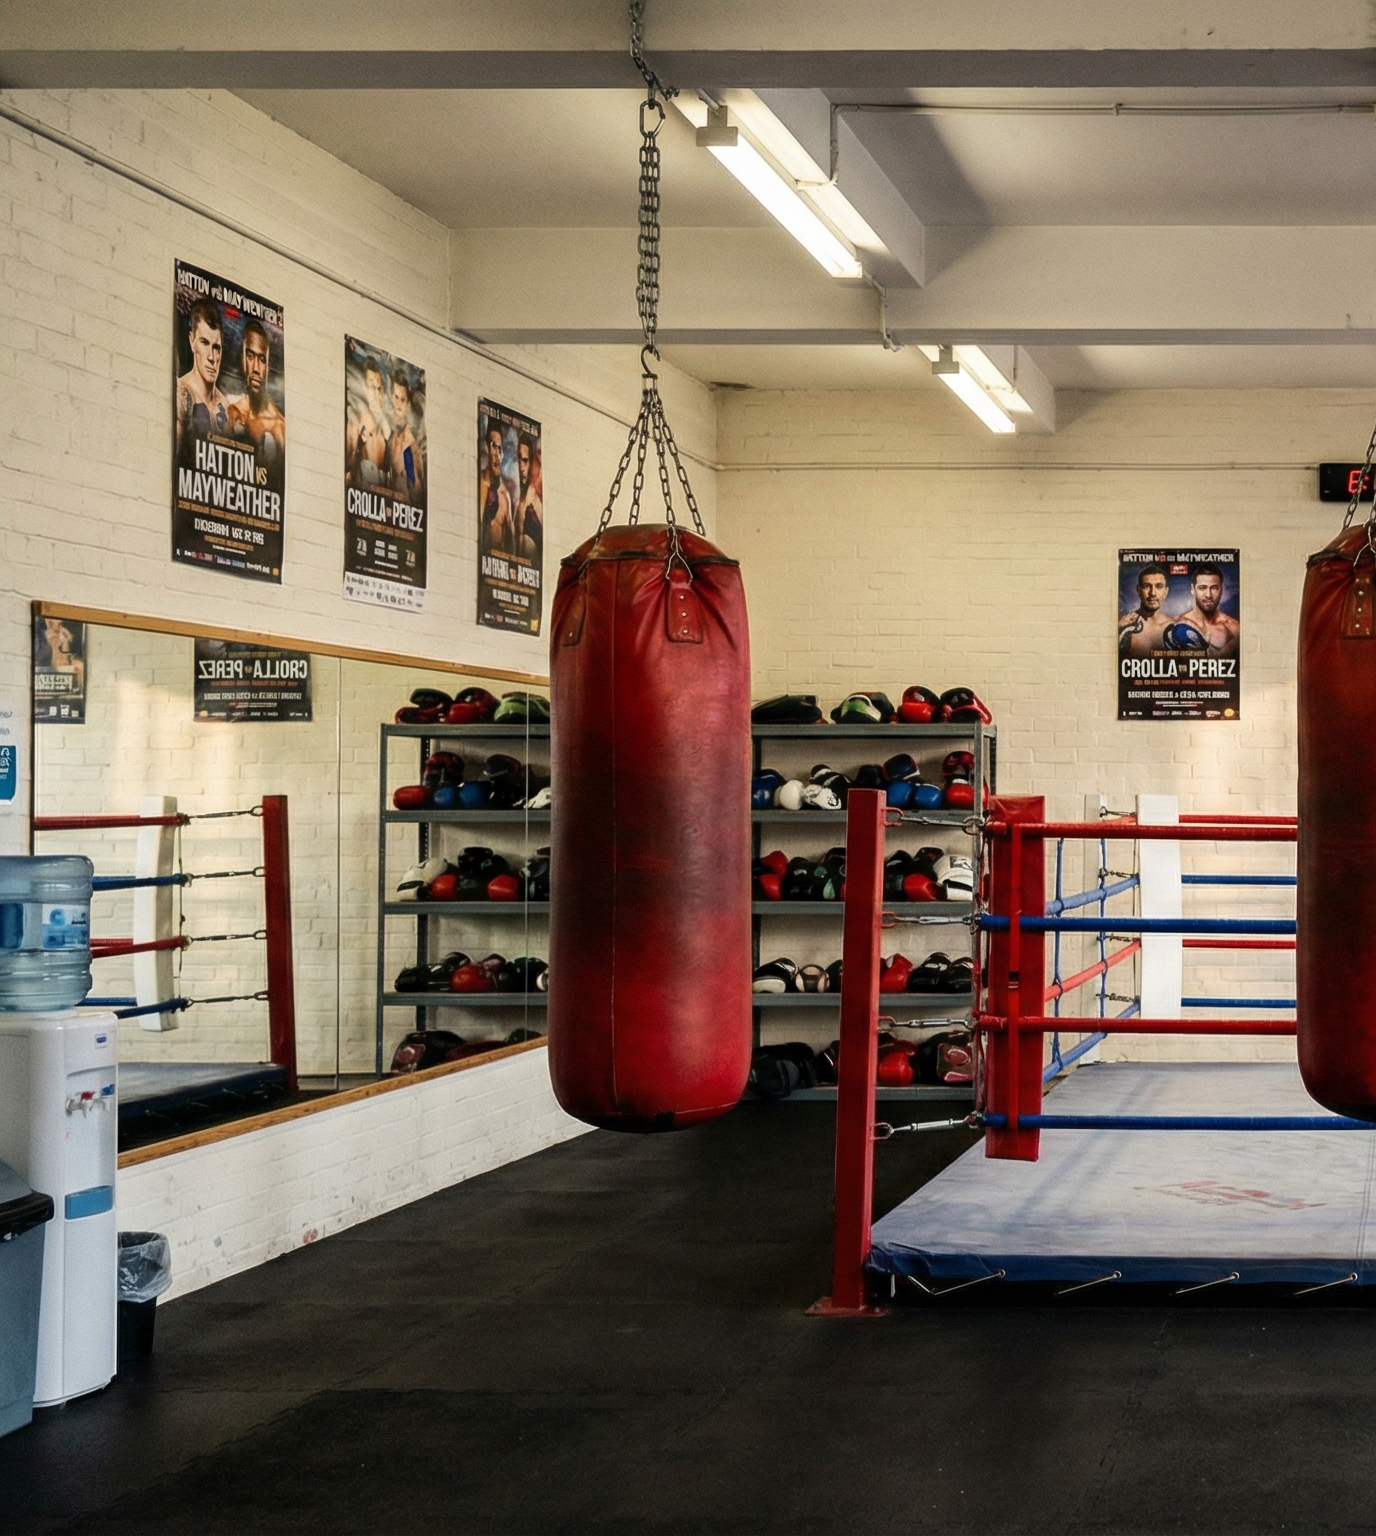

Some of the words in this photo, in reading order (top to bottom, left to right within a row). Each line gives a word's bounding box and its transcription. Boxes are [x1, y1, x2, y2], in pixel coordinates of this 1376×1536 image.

[195, 439, 255, 484] HATTON
[255, 466, 268, 485] VS
[178, 467, 281, 522] MAYWEATHER
[347, 487, 387, 523] CROLLA
[392, 501, 424, 532] PEREZ
[1121, 658, 1178, 678] CROLLA
[1188, 658, 1236, 678] PEREZ
